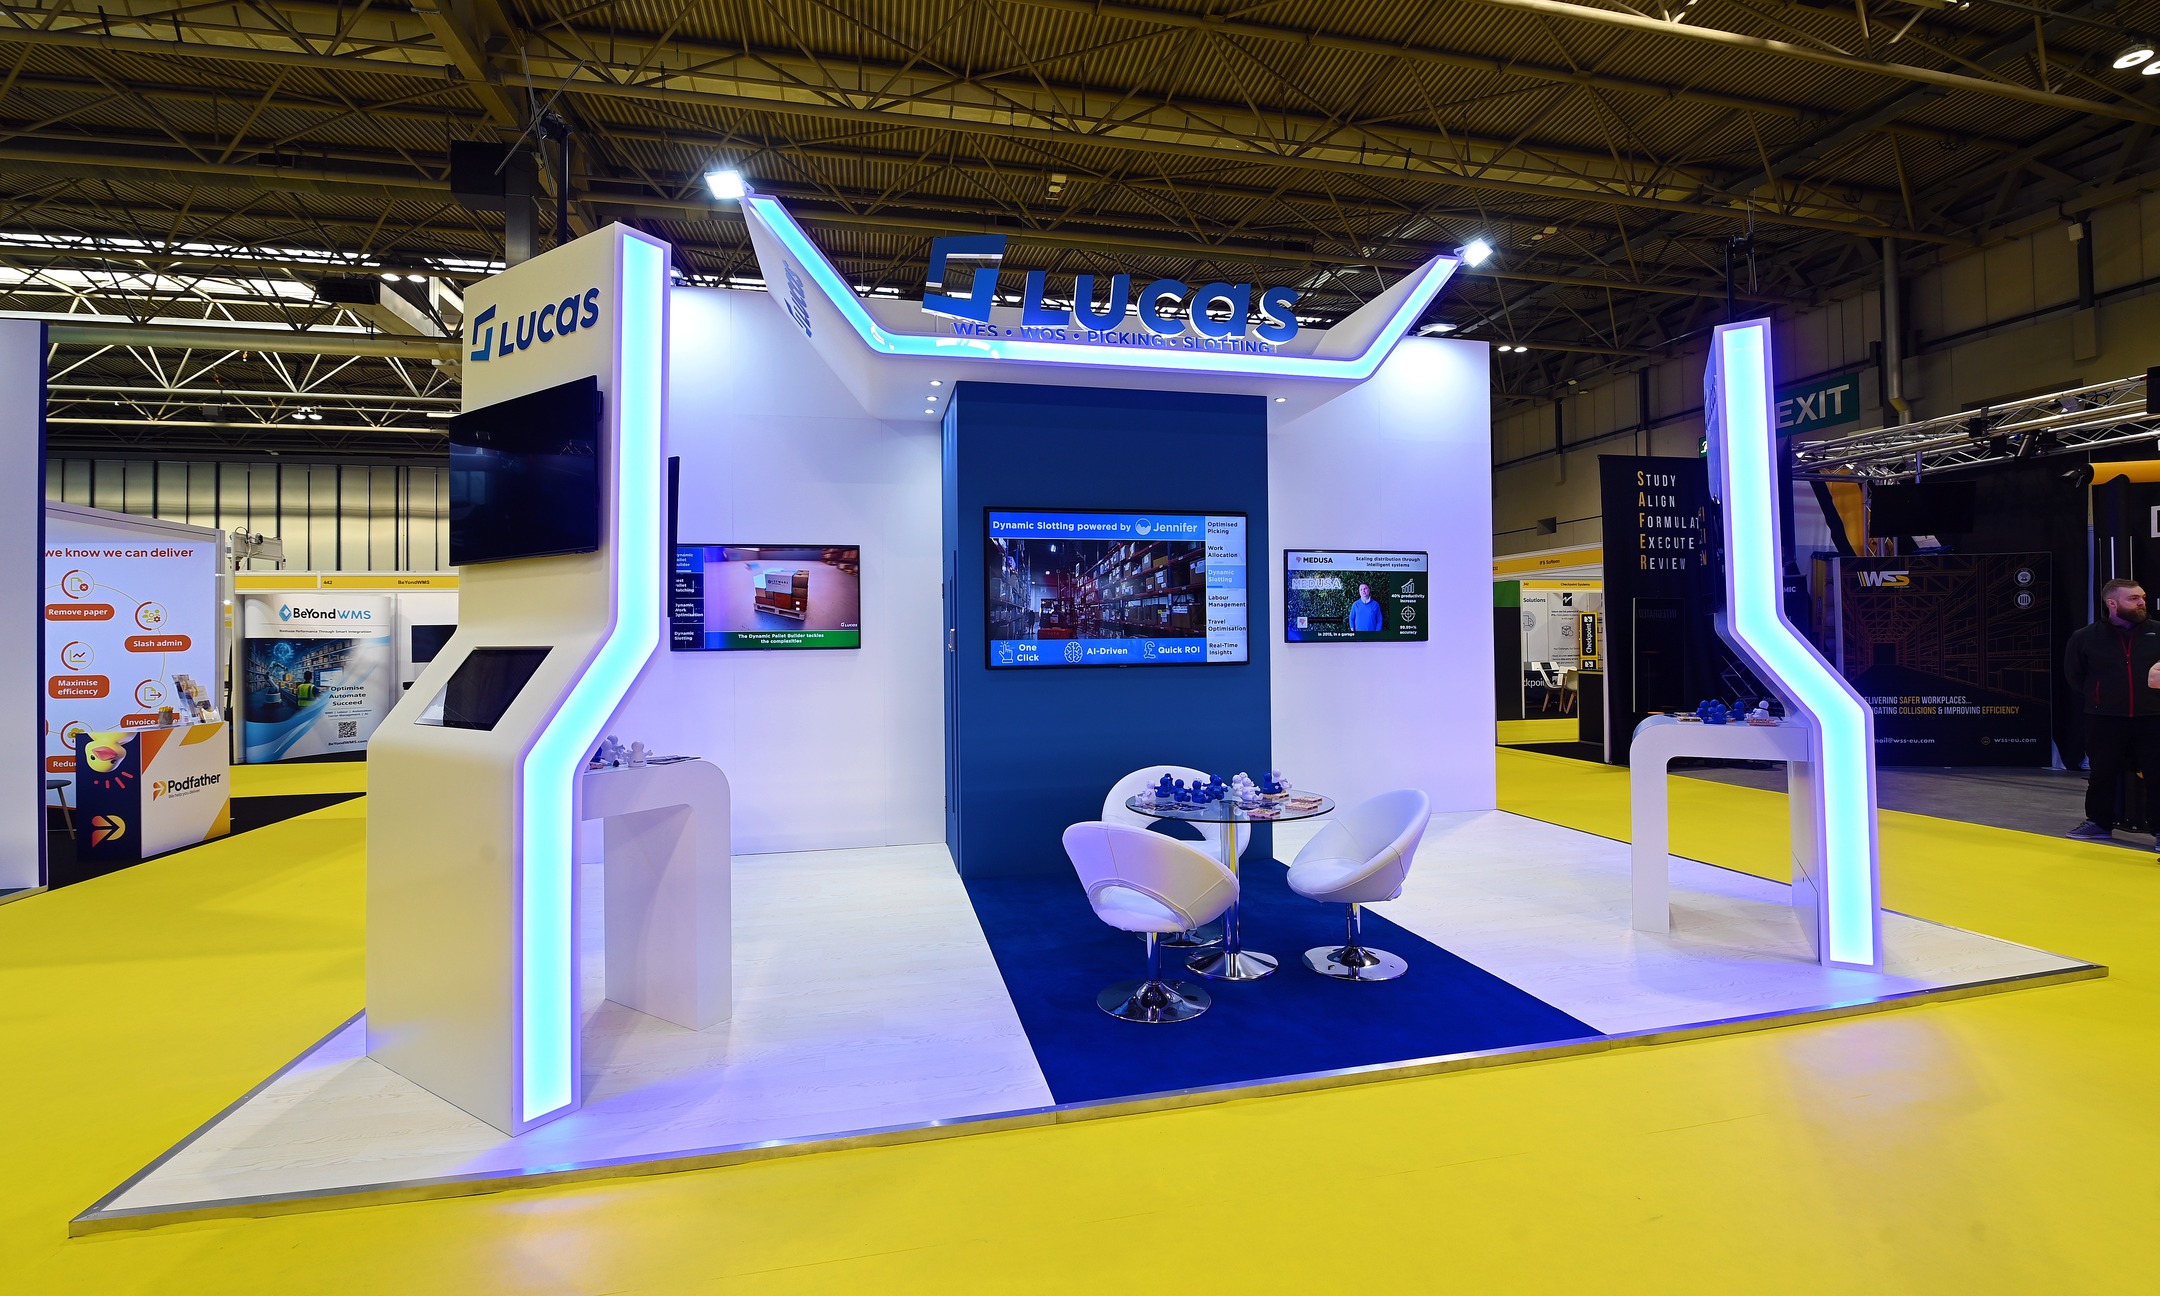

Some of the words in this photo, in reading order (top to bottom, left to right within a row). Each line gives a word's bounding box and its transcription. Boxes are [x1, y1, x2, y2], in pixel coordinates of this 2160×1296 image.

[953, 322, 998, 337] WES
[1020, 327, 1066, 341] WOS
[1087, 330, 1164, 347] PICKING
[1183, 336, 1270, 353] SLOTTING
[1775, 383, 1849, 429] EXIT
[1639, 512, 1699, 529] FORMULAT
[993, 521, 1034, 530] Dynamic
[1037, 521, 1075, 532] Slotting
[1077, 523, 1117, 532] powered
[1120, 523, 1131, 532] by
[1153, 523, 1198, 532] Jennifer
[45, 549, 62, 557] we
[65, 548, 100, 557] know
[103, 549, 122, 557] we
[125, 549, 148, 557] can
[151, 548, 193, 557] deliver
[1292, 578, 1342, 589] MEDUSA
[1863, 571, 1910, 587] WSS
[83, 609, 108, 617] paper
[1585, 623, 1593, 653] Checkpoint
[1086, 647, 1128, 655] AI-Driven
[1158, 646, 1182, 654] Quick
[1016, 654, 1039, 662] Click
[57, 688, 98, 696] efficiency
[1899, 697, 1921, 705] SAFER
[1921, 696, 1972, 705] WORKPLACES...
[1898, 706, 1937, 715] COLLISIONS
[1938, 706, 1943, 715] &
[1944, 706, 1981, 715] IMPROVING
[1981, 706, 2020, 715] EFFICIENCY
[168, 773, 221, 793] Podfather
